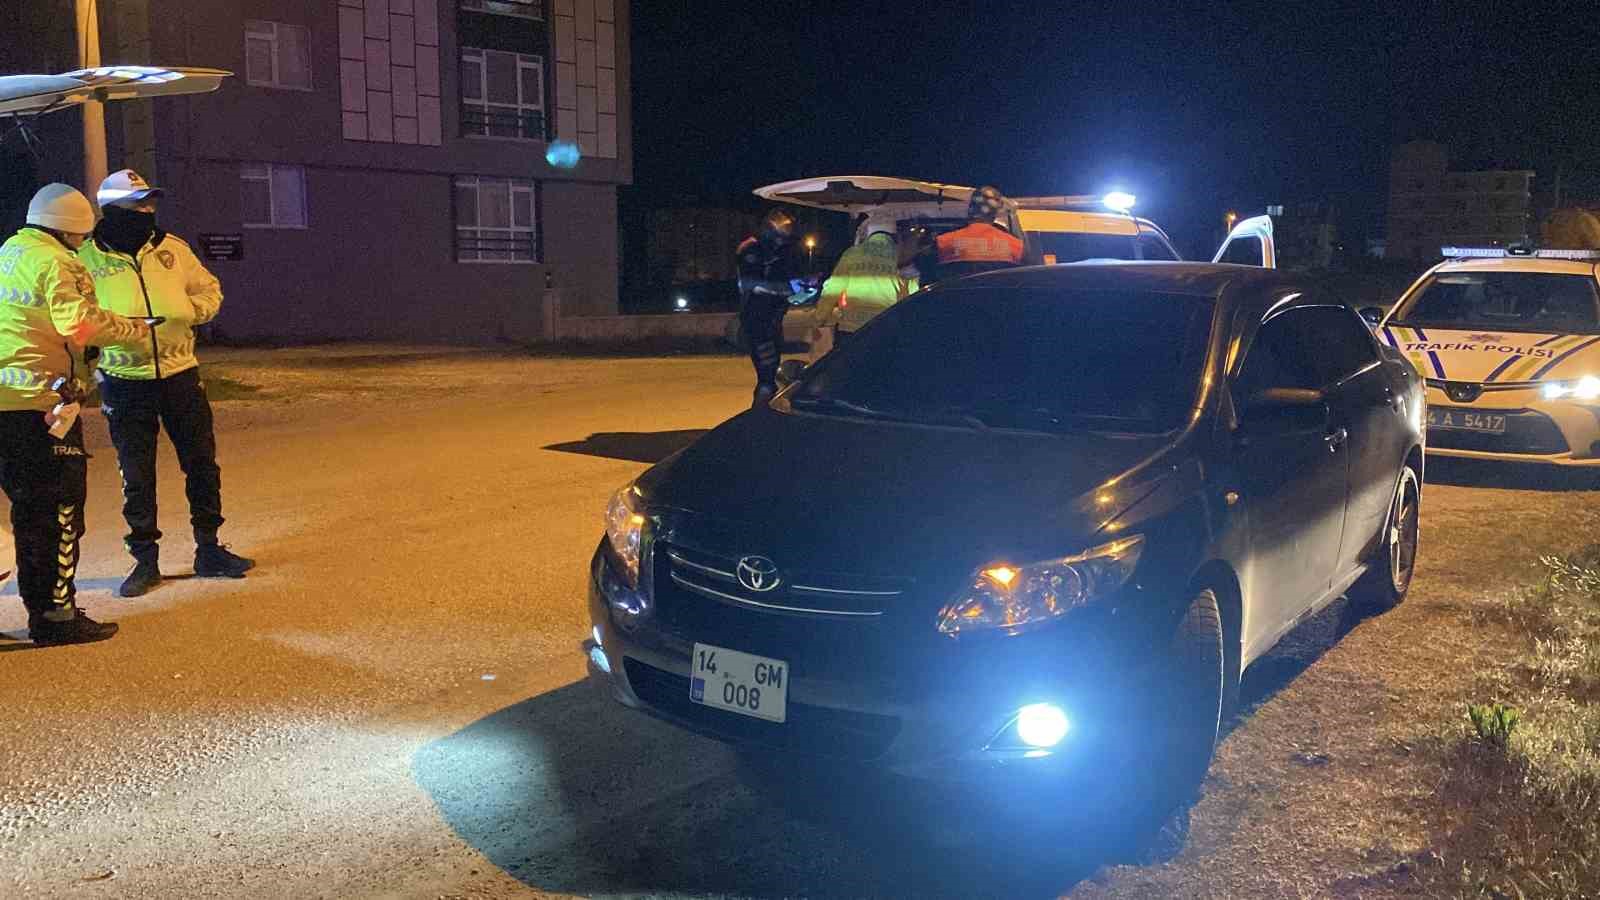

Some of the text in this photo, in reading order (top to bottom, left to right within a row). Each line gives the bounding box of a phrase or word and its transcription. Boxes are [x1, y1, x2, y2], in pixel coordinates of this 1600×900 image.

[1443, 412, 1453, 426] A
[1464, 414, 1504, 429] 5417
[699, 650, 783, 689] 14 GM
[723, 681, 761, 710] 008
